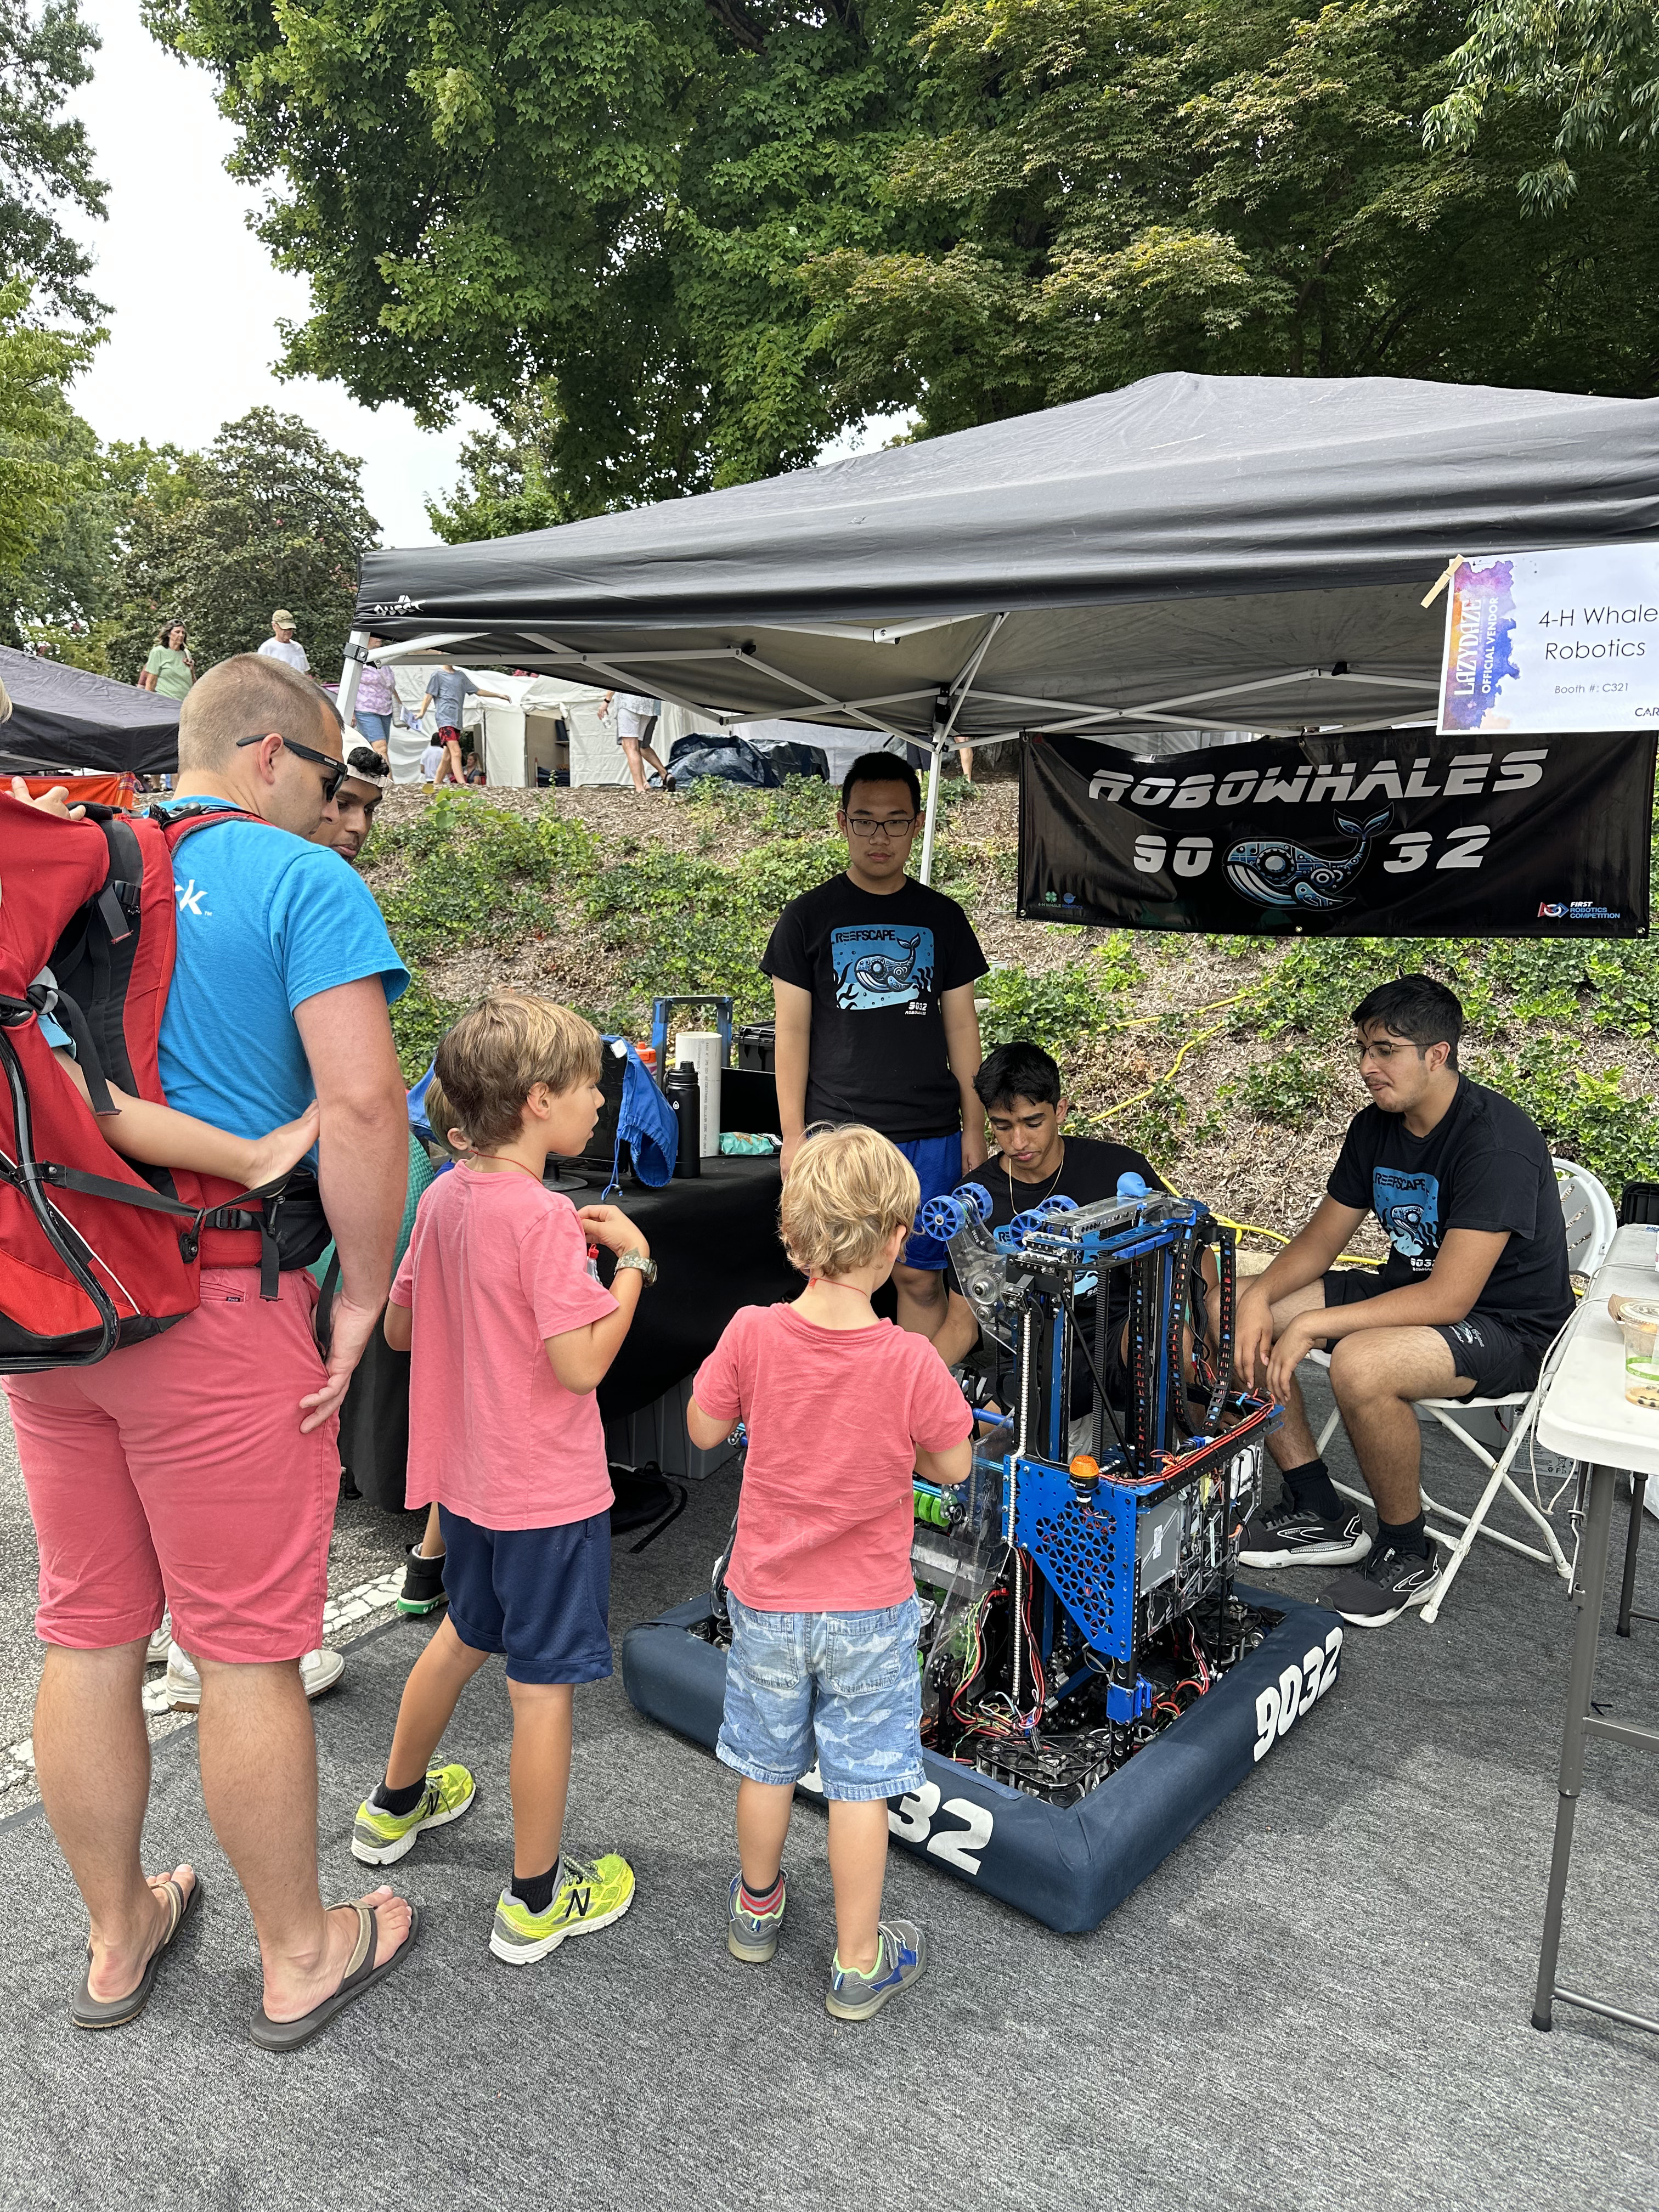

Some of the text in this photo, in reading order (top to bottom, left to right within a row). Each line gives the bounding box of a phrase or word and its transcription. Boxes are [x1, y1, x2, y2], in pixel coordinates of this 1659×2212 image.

[1486, 597, 1499, 645] VENDOR
[1538, 604, 1658, 628] 4-H Whale
[1545, 639, 1646, 660] Robotics
[1481, 646, 1495, 694] OFFICIAL
[1555, 685, 1585, 694] Booth
[1602, 682, 1628, 692] C321
[1088, 748, 1548, 809] ROBOWHALES
[1133, 825, 1491, 877] 90 32
[835, 929, 896, 943] REEFSCAPE
[1374, 1172, 1426, 1191] REEFSCAPE
[1254, 1626, 1343, 1762] 9032
